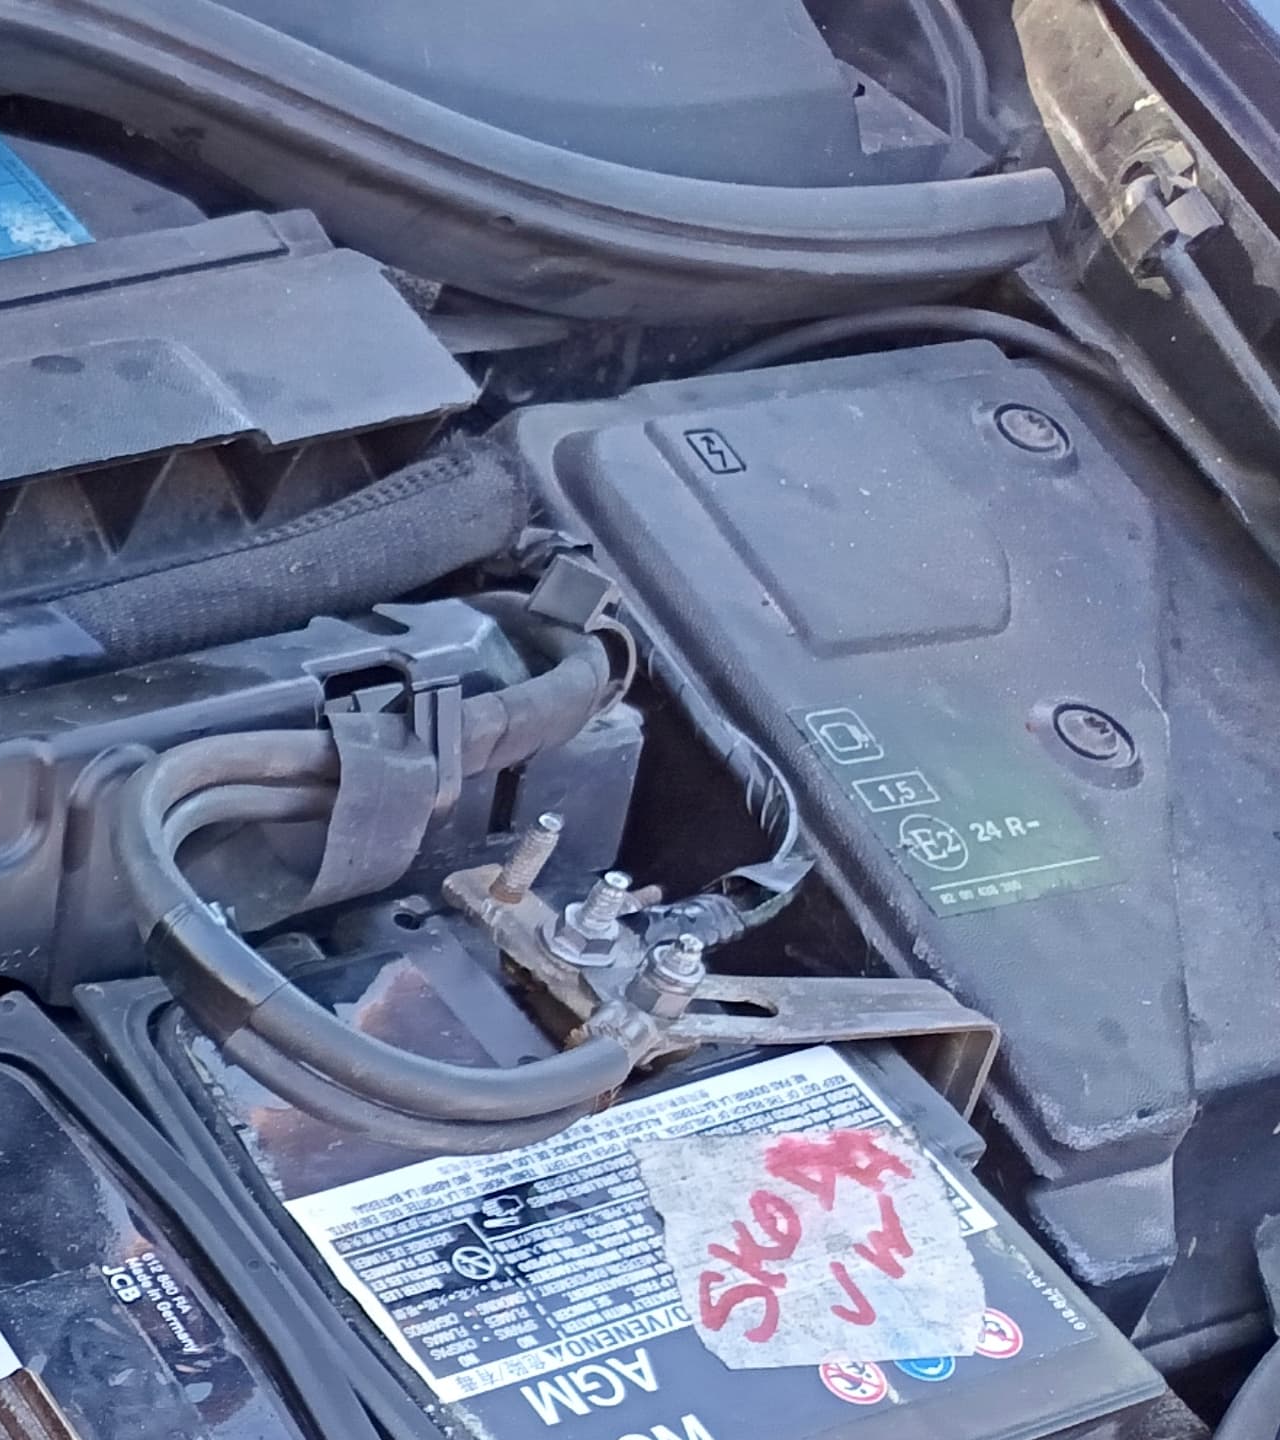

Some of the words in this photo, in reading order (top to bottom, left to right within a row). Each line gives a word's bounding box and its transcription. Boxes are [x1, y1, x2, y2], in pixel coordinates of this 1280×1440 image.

[877, 780, 917, 806] 1,5
[910, 828, 962, 862] E2
[968, 820, 1003, 843] 24
[769, 1078, 792, 1090] PAS
[378, 1206, 404, 1221] DES
[698, 1129, 913, 1344] SKODA
[101, 1265, 142, 1303] JCB
[125, 1256, 154, 1288] Made
[146, 1288, 162, 1302] in
[155, 1301, 202, 1355] Germany
[493, 1318, 538, 1340] SPARKS
[516, 1334, 538, 1349] NO
[457, 1352, 480, 1367] NO
[518, 1347, 659, 1427] AGM
